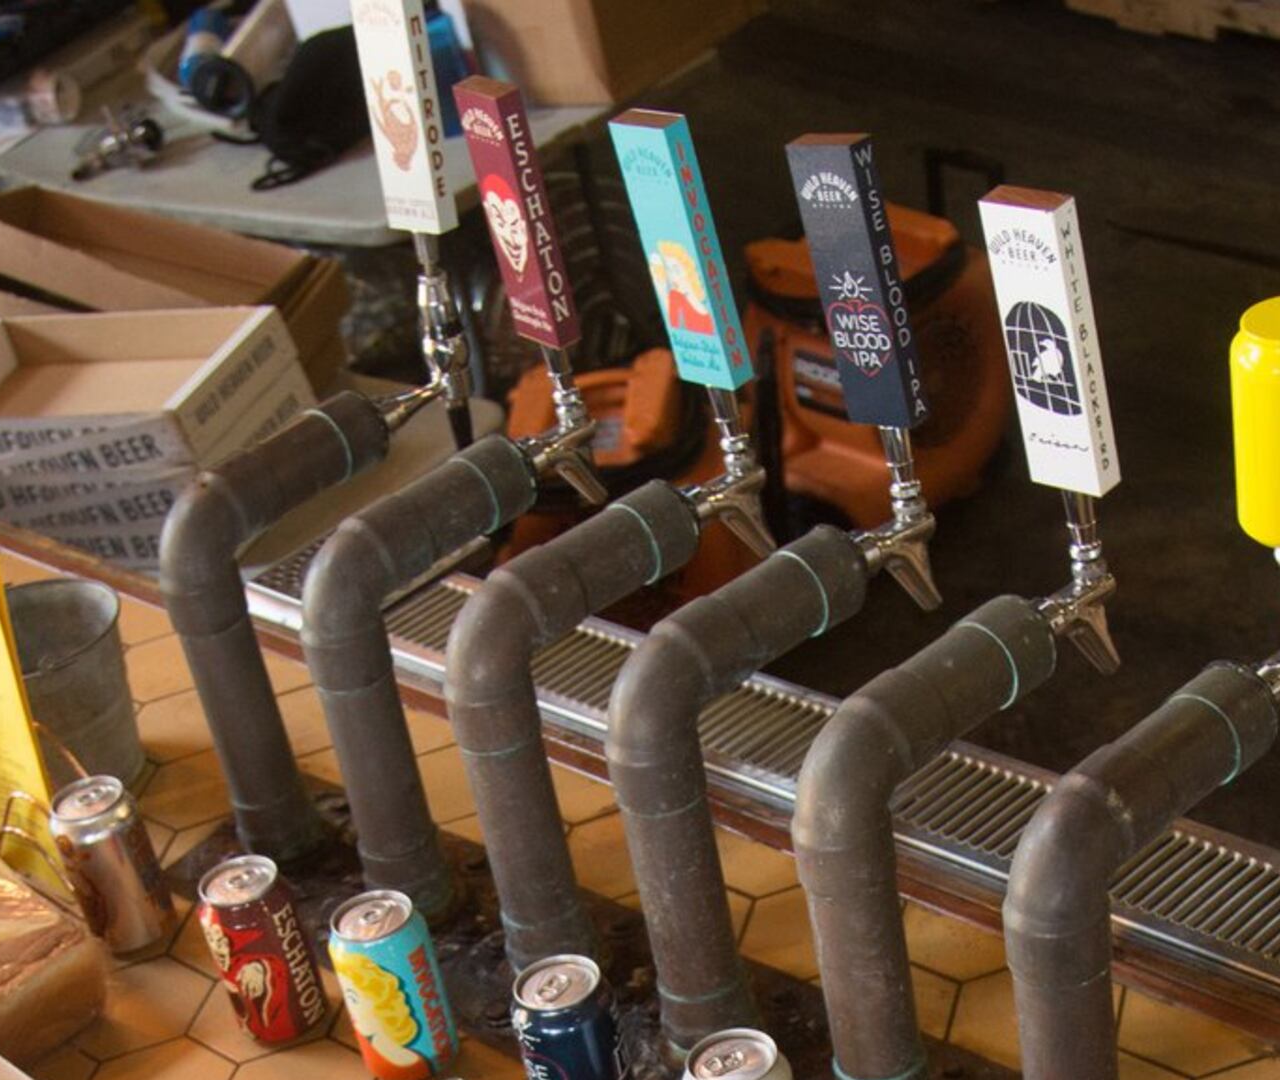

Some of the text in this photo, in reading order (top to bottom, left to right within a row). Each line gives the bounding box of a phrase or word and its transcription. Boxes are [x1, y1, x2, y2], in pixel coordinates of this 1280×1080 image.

[801, 172, 859, 201] WILD HEAVEN
[817, 190, 843, 202] BEER
[506, 113, 570, 323] ESCHATON
[676, 141, 743, 367] INVOCATION
[989, 229, 1057, 265] WILD HEAVEN
[1007, 246, 1036, 262] BEER
[854, 145, 926, 417] WISE BLOOD IPA
[836, 313, 882, 333] WISE
[833, 330, 892, 352] BLOOD
[1060, 224, 1111, 471] WHITE BLACKBIRD
[853, 351, 883, 369] IPA
[100, 433, 163, 468] BEER
[272, 902, 325, 1025] ESCHATON
